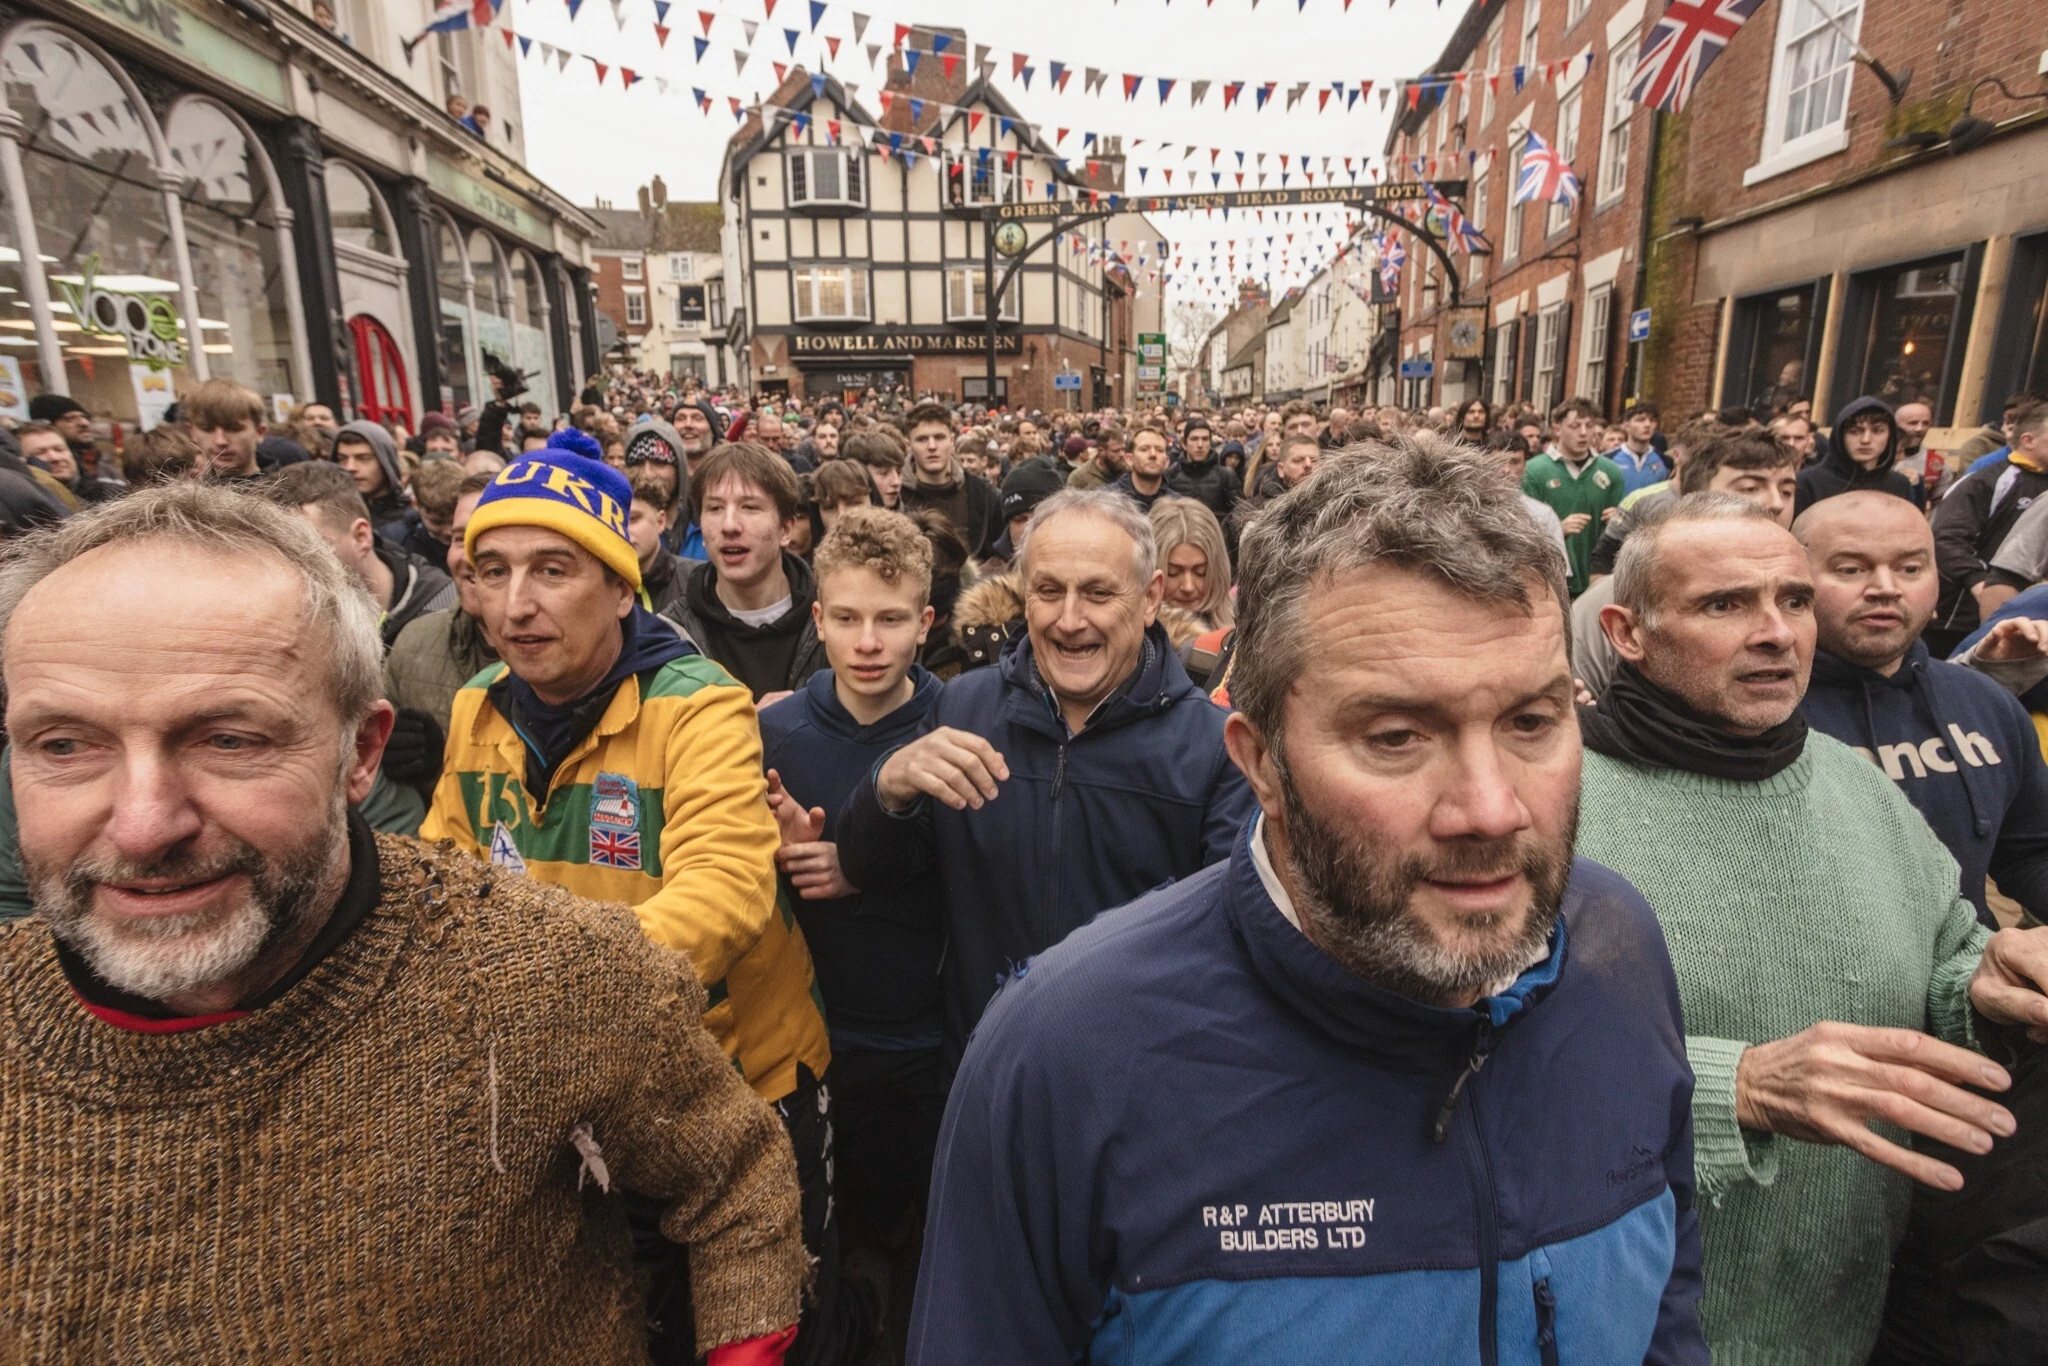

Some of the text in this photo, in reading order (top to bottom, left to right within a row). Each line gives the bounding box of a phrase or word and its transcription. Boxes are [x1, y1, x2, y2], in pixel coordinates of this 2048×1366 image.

[1000, 203, 1060, 218] GREEN
[1073, 200, 1113, 215] MAN
[1125, 198, 1139, 212] &
[1236, 191, 1289, 206] HEAD
[1301, 188, 1363, 203] ROYAL
[1375, 183, 1427, 200] HOTE
[133, 333, 184, 364] ZONE
[796, 335, 879, 350] HOWELL
[883, 335, 923, 350] AND
[495, 461, 626, 537] UKR
[1202, 1198, 1375, 1227] R&P ATTERBURY
[1220, 1226, 1366, 1251] BUILDERS LTD
